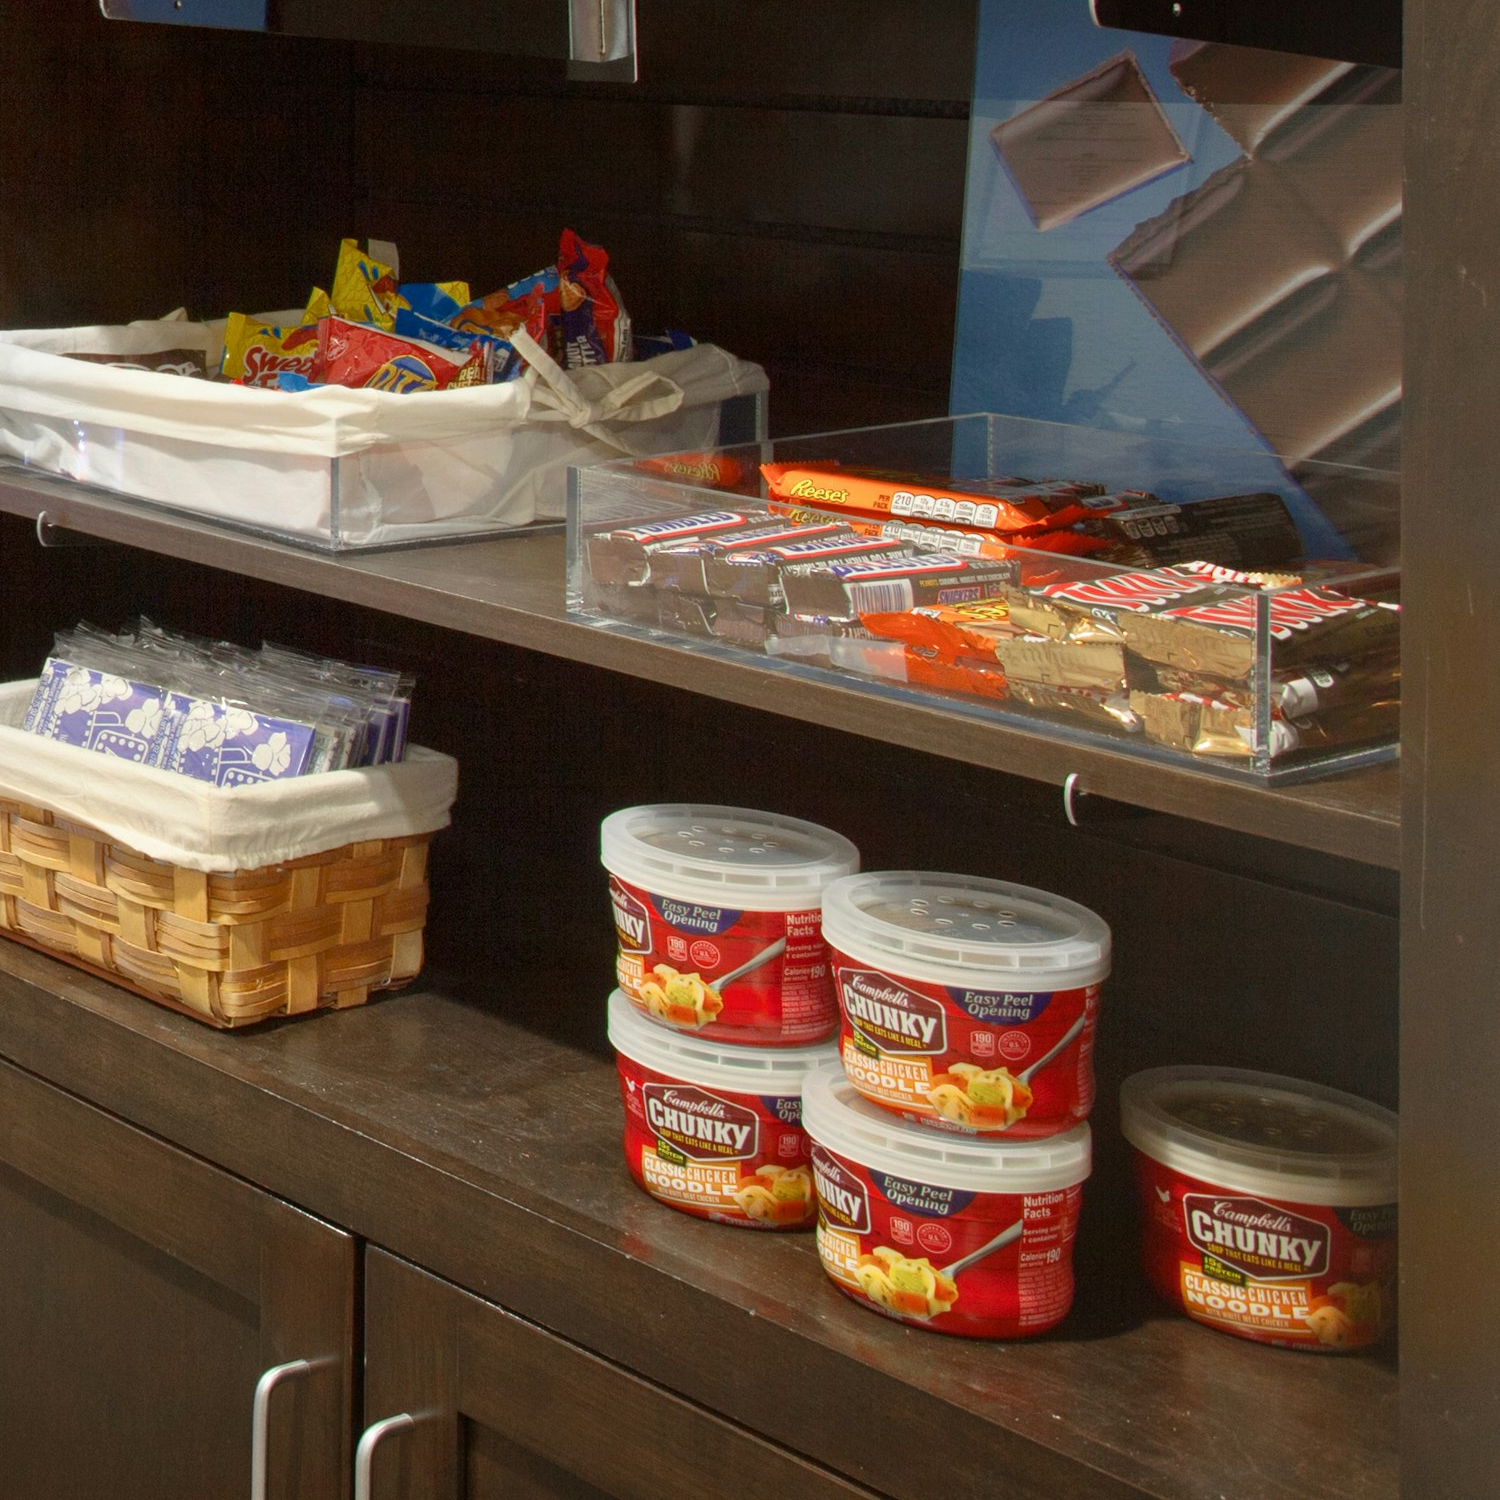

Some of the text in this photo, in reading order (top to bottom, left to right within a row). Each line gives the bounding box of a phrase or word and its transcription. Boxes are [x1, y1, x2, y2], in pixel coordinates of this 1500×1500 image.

[790, 479, 850, 504] Reese's
[894, 493, 911, 506] 210
[661, 900, 721, 920] Easy Peel
[664, 910, 718, 933] Opening
[787, 925, 814, 936] Facts
[811, 964, 826, 979] 190
[852, 973, 910, 1007] Campbell's
[964, 991, 1033, 1007] Easy Peel
[843, 984, 937, 1044] CHUNKY
[968, 1003, 1031, 1020] Opening
[974, 1033, 992, 1044] 190
[845, 1065, 932, 1095] NOODLE
[880, 1060, 929, 1081] CHICKEN
[663, 1087, 726, 1120] Campbell's
[649, 1097, 751, 1150] CHUNKY
[645, 1158, 737, 1184] CLASSIC CHICKEN
[645, 1172, 738, 1196] NOODLE
[883, 1176, 953, 1201] Easy Peel
[886, 1189, 950, 1214] Opening
[1023, 1193, 1064, 1206] Nutrition
[1023, 1207, 1051, 1219] Facts
[1213, 1199, 1292, 1233] Campbell's
[893, 1219, 910, 1232] 190
[1191, 1209, 1321, 1267] CHUNKY
[1046, 1249, 1061, 1264] 190
[1206, 1242, 1223, 1255] SOUP
[1225, 1247, 1241, 1260] THAT
[1242, 1252, 1258, 1265] EATS
[1261, 1257, 1275, 1268] LIKE
[1284, 1261, 1302, 1273] MEAL
[1204, 1263, 1242, 1280] PROTEIN
[1185, 1275, 1308, 1306] CLASSIC CHICKEN
[1186, 1290, 1309, 1320] NOODLE
